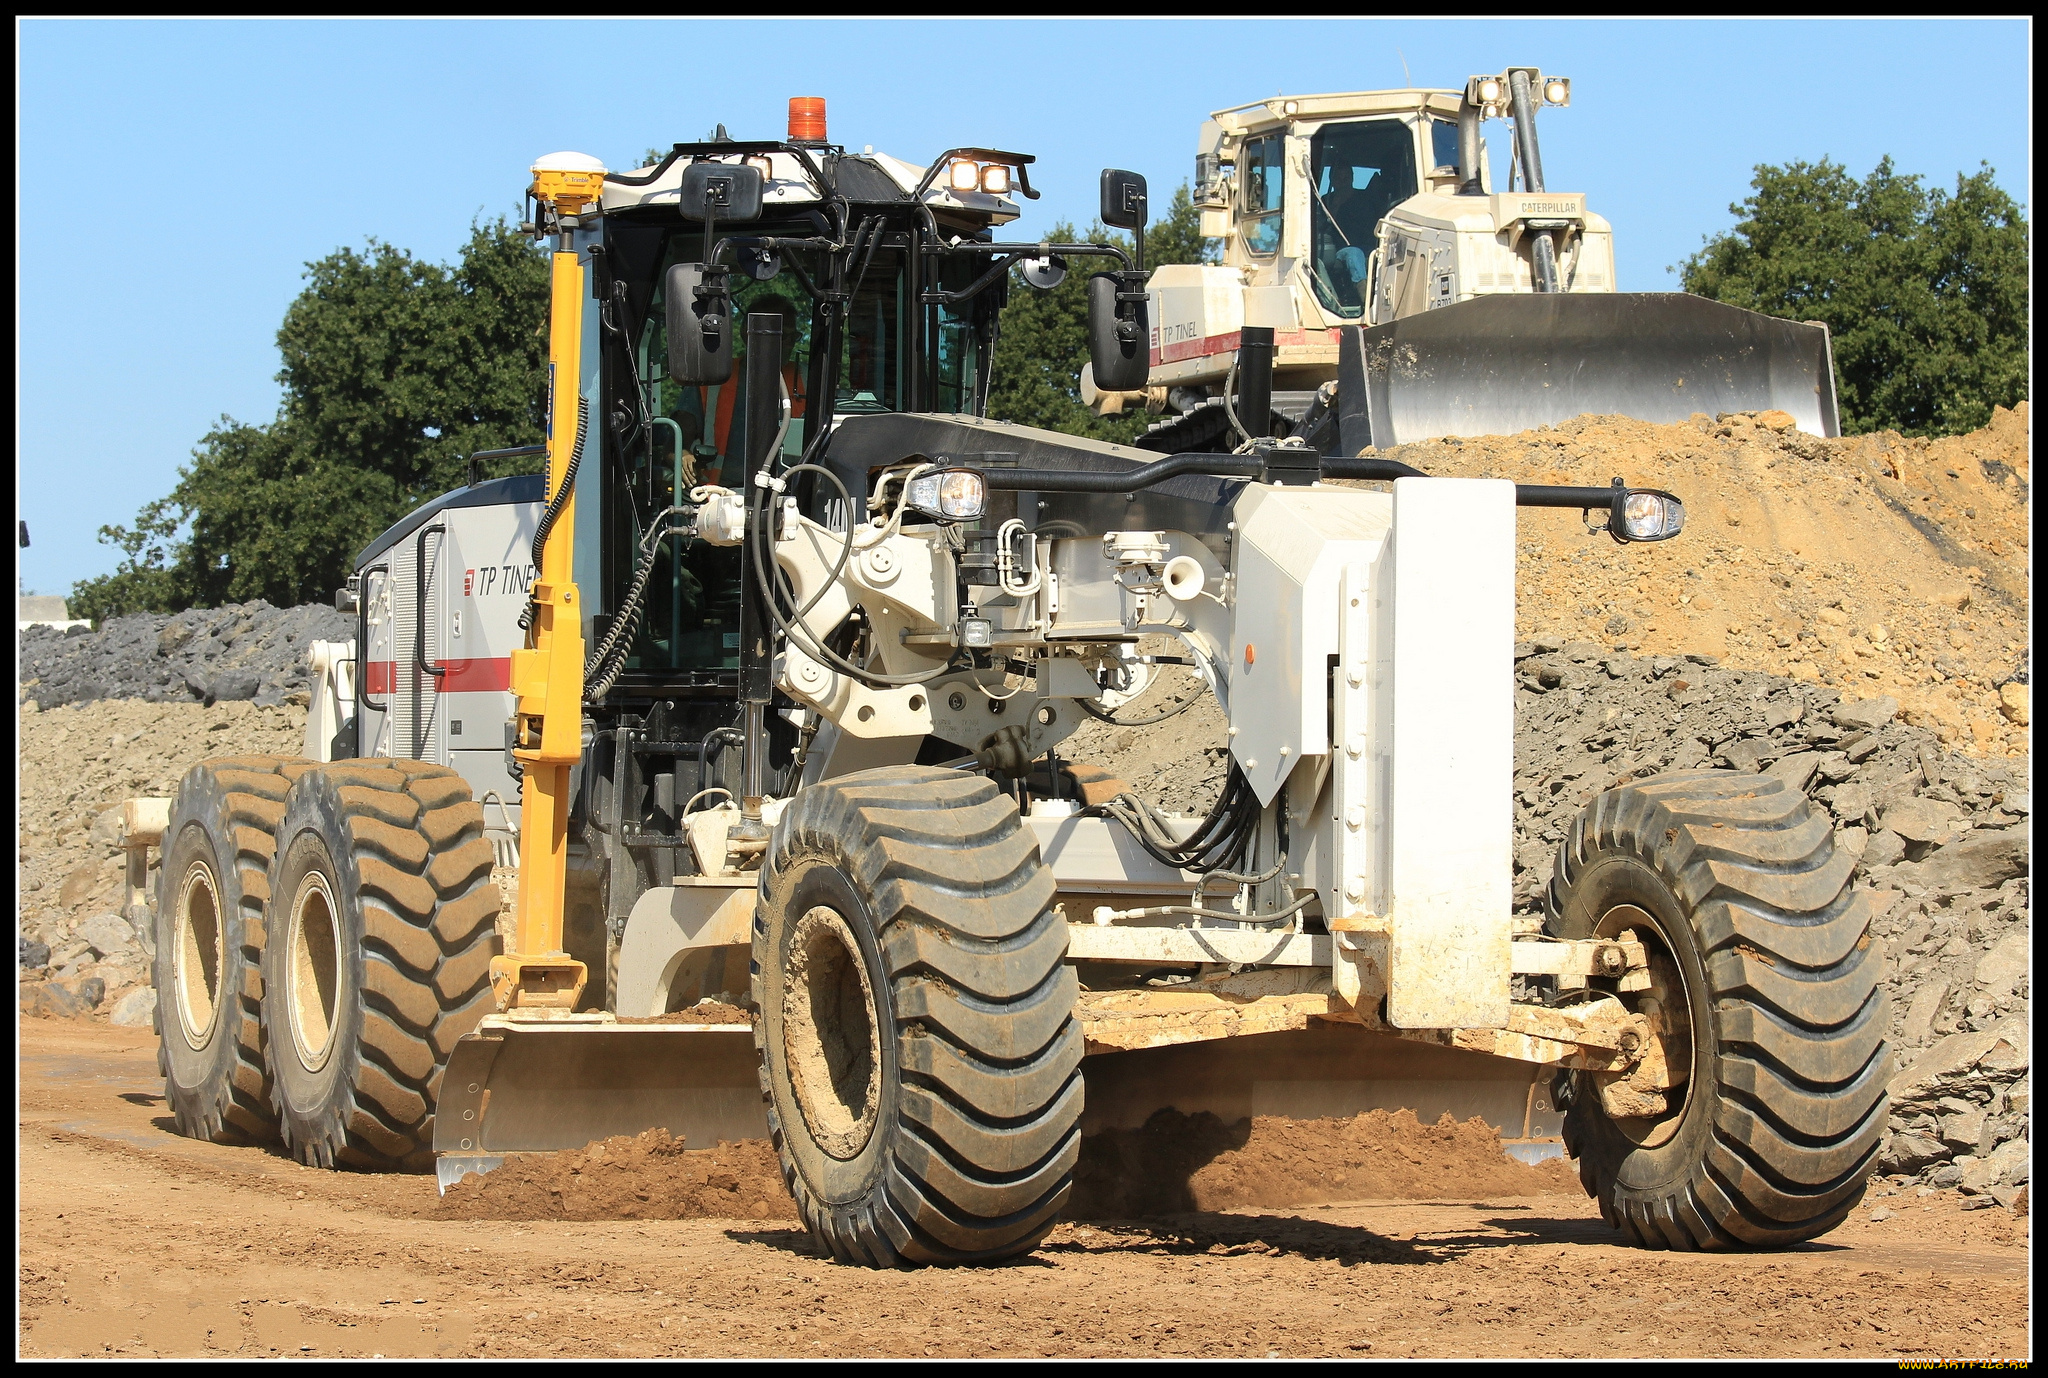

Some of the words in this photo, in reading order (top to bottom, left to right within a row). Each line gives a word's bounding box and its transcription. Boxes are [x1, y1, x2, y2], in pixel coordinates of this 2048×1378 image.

[1521, 202, 1577, 213] CATERPILLAR
[1163, 326, 1173, 343] TP
[1175, 321, 1198, 341] TINEL
[479, 566, 497, 596] TP
